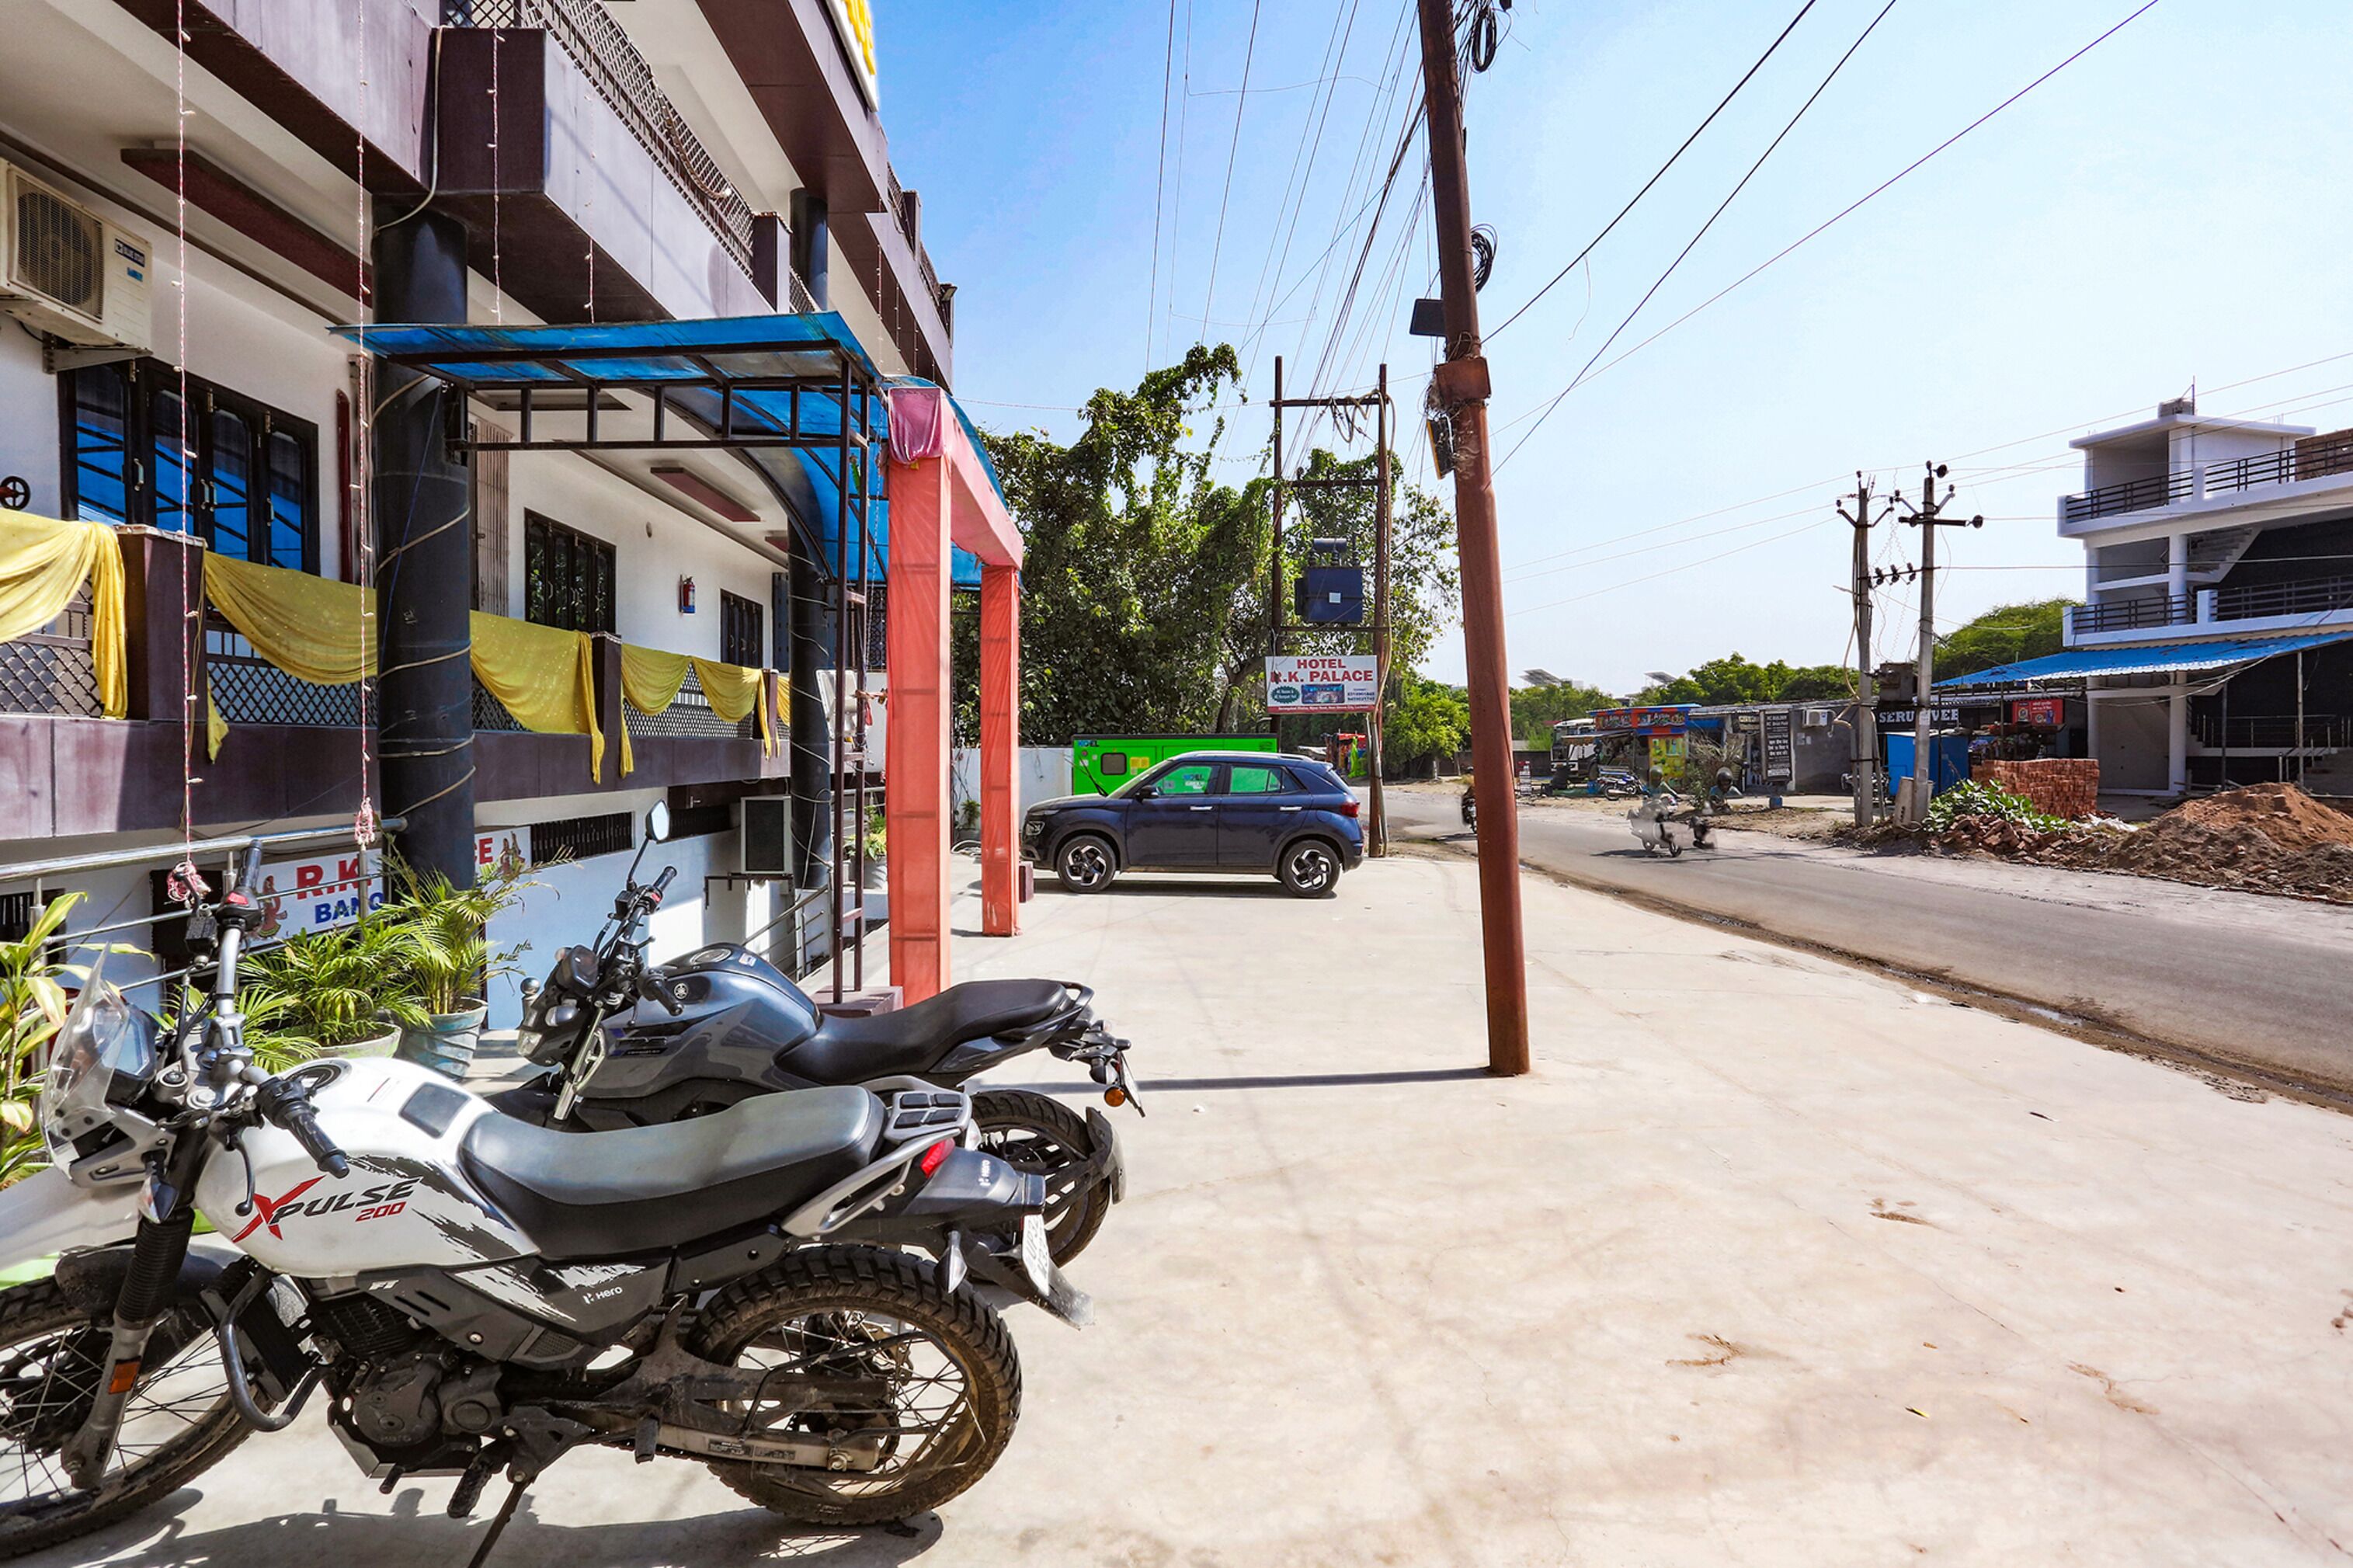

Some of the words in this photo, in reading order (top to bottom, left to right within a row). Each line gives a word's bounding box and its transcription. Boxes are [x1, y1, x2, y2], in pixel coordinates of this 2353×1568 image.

[1297, 659, 1347, 669] HOTEL
[1270, 670, 1304, 683] R.K.
[1309, 669, 1374, 682] PALACE
[231, 1174, 424, 1243] XPULSE
[355, 1201, 407, 1222] 200
[595, 1286, 623, 1299] Hero
